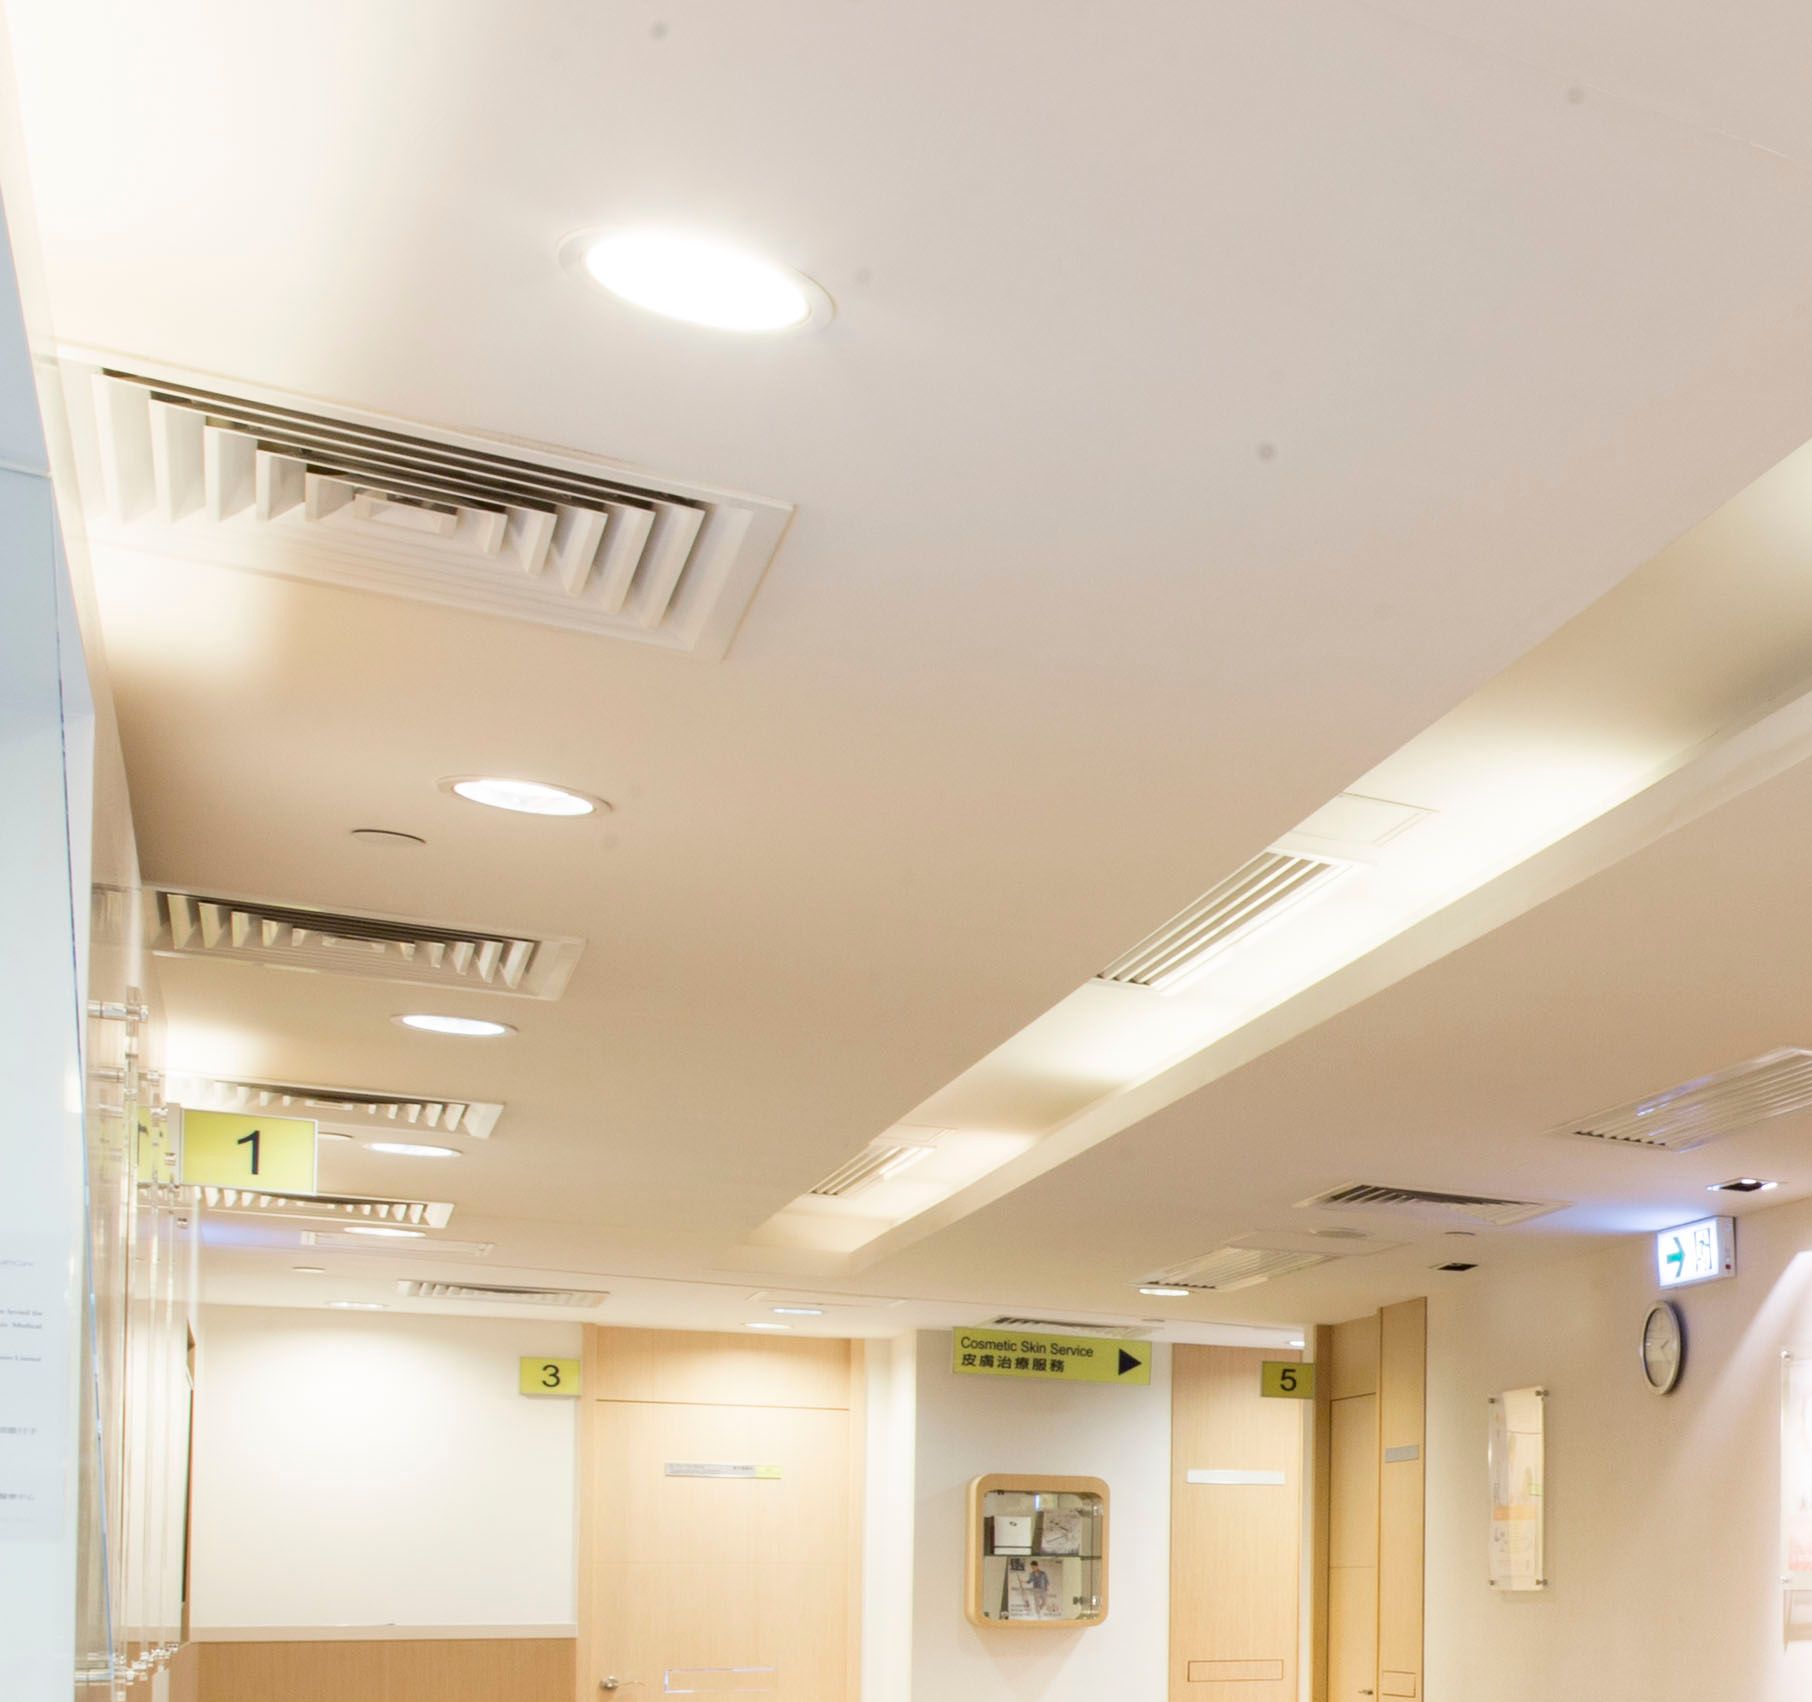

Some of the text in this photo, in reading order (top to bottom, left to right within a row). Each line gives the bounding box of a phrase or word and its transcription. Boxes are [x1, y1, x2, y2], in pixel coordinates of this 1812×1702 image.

[237, 1130, 260, 1175] 1
[960, 1336, 1094, 1358] Cosmetic Skin Service
[961, 1353, 1065, 1373] 皮膚治療服務
[542, 1364, 560, 1388] 3
[1280, 1368, 1297, 1392] 5
